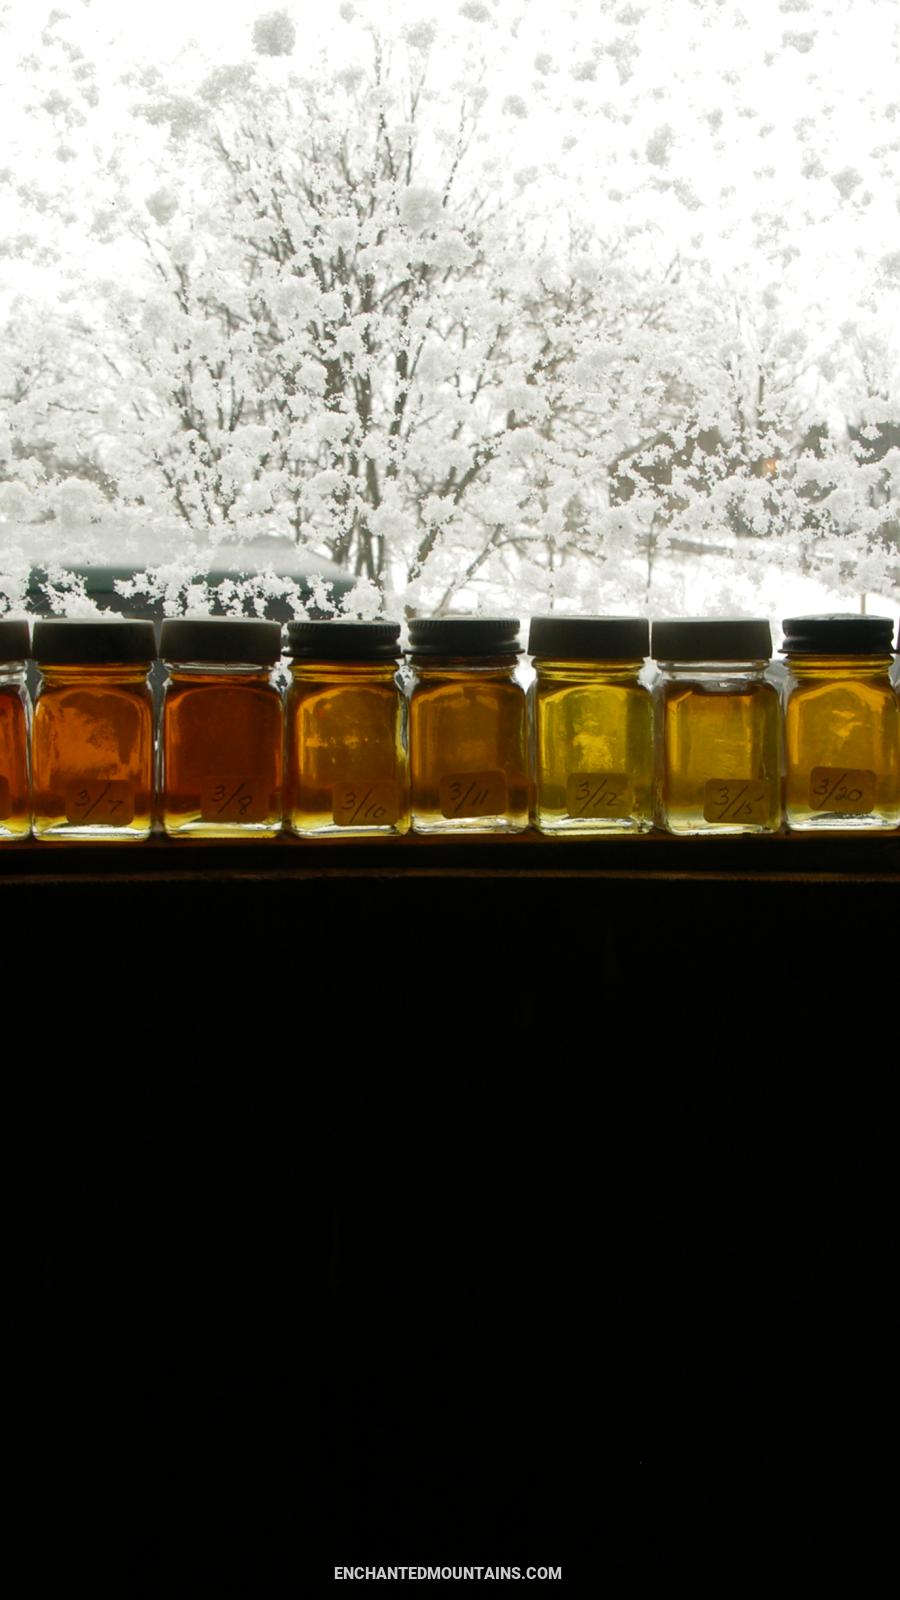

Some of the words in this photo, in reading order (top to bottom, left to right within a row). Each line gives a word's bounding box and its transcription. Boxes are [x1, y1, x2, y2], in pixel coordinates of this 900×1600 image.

[74, 780, 123, 820] 3/7
[211, 782, 254, 815] 3/8
[341, 787, 386, 823] 3/10
[449, 779, 489, 815] 3/11
[575, 776, 624, 814] 3/12
[812, 771, 863, 808] 3/20
